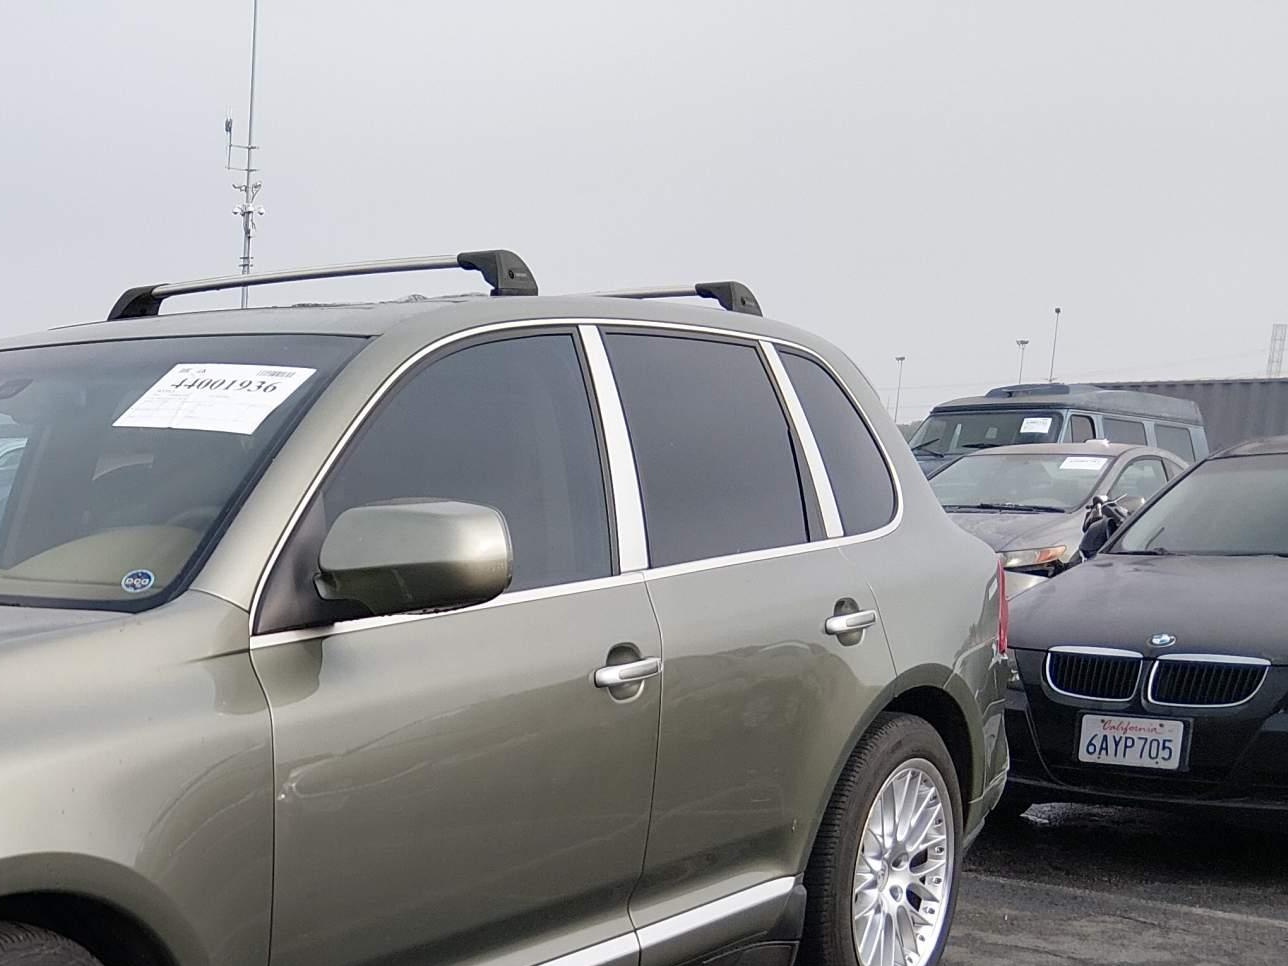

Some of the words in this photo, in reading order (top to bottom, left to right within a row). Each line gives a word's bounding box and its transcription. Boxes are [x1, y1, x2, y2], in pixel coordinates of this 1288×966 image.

[171, 378, 281, 393] 44001936
[1102, 720, 1159, 735] California
[1086, 734, 1173, 761] 6AYP705
